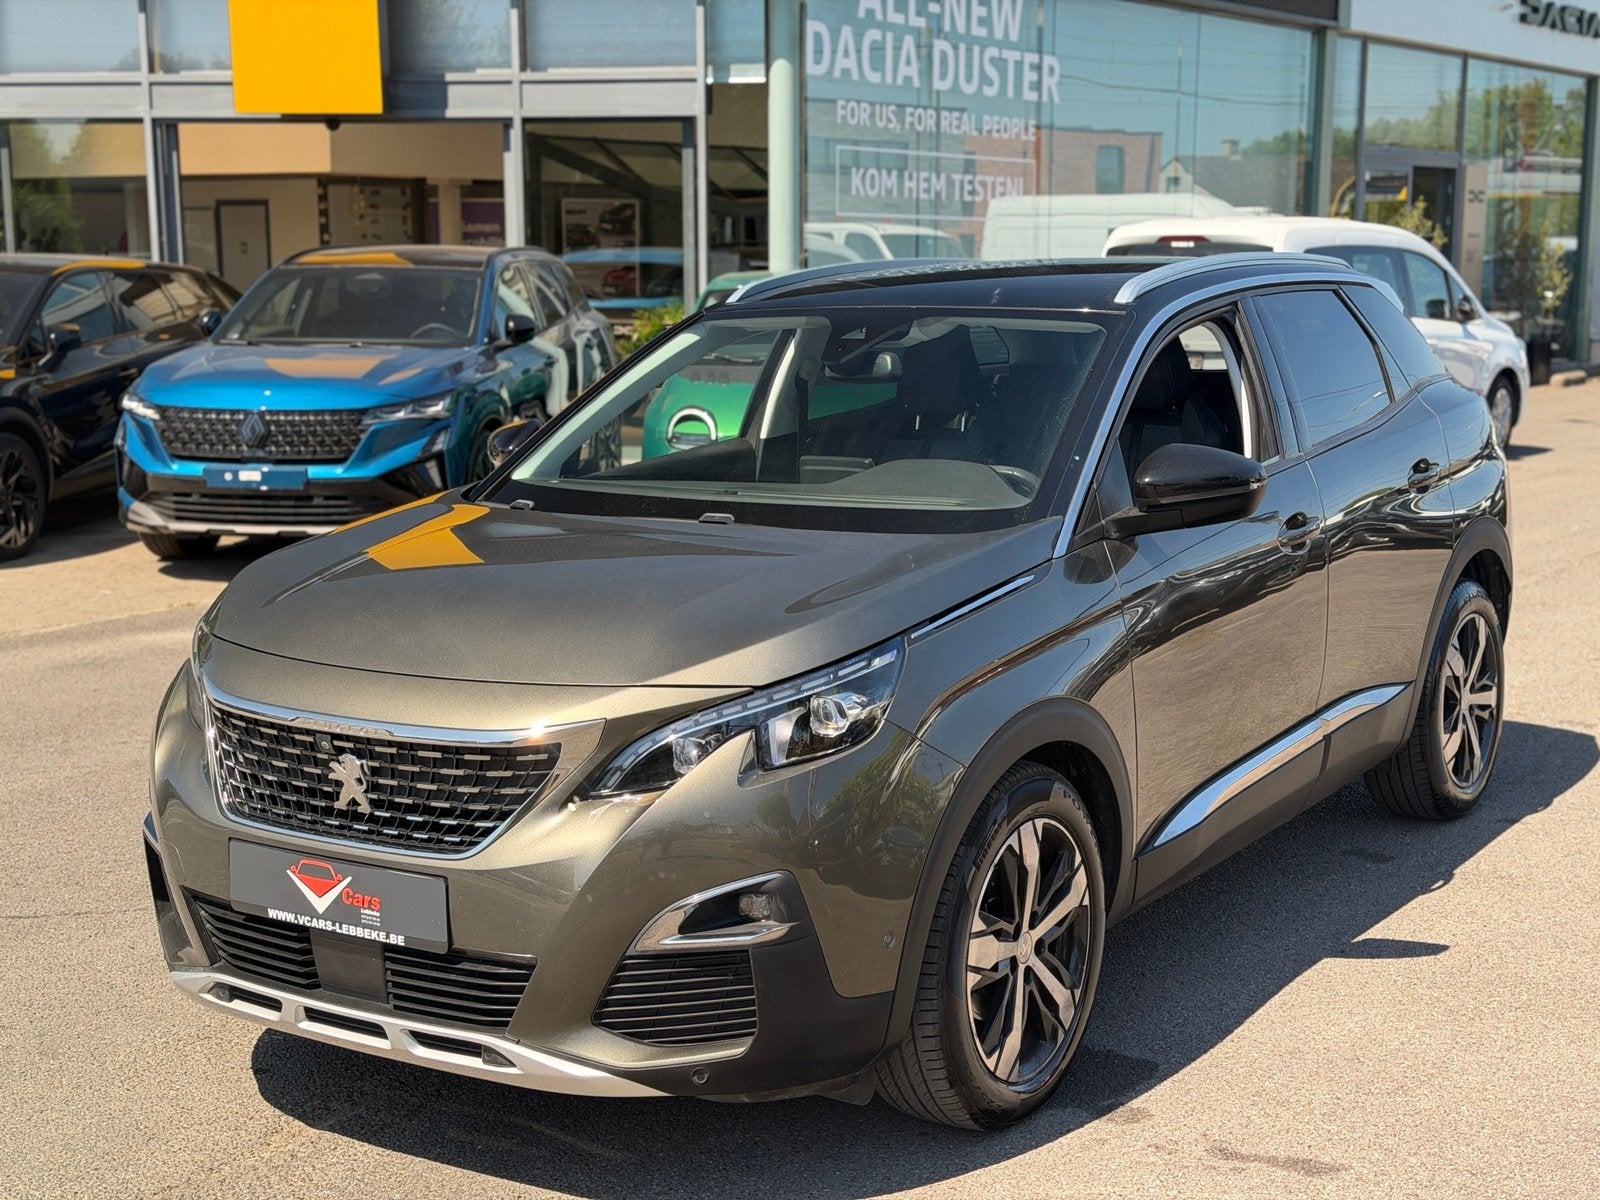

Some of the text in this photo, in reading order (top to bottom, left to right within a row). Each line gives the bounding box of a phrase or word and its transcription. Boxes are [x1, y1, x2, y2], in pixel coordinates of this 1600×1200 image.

[857, 0, 1024, 42] ALL-NEW
[805, 19, 1061, 103] DACIA DUSTER
[836, 99, 1037, 142] FOR US, FOR REAL PEOPLE
[850, 166, 898, 197] KOM
[903, 170, 946, 200] HEM
[342, 887, 381, 911] Cars
[267, 907, 406, 946] WWW.VCARS-LEBBEKE.BE
